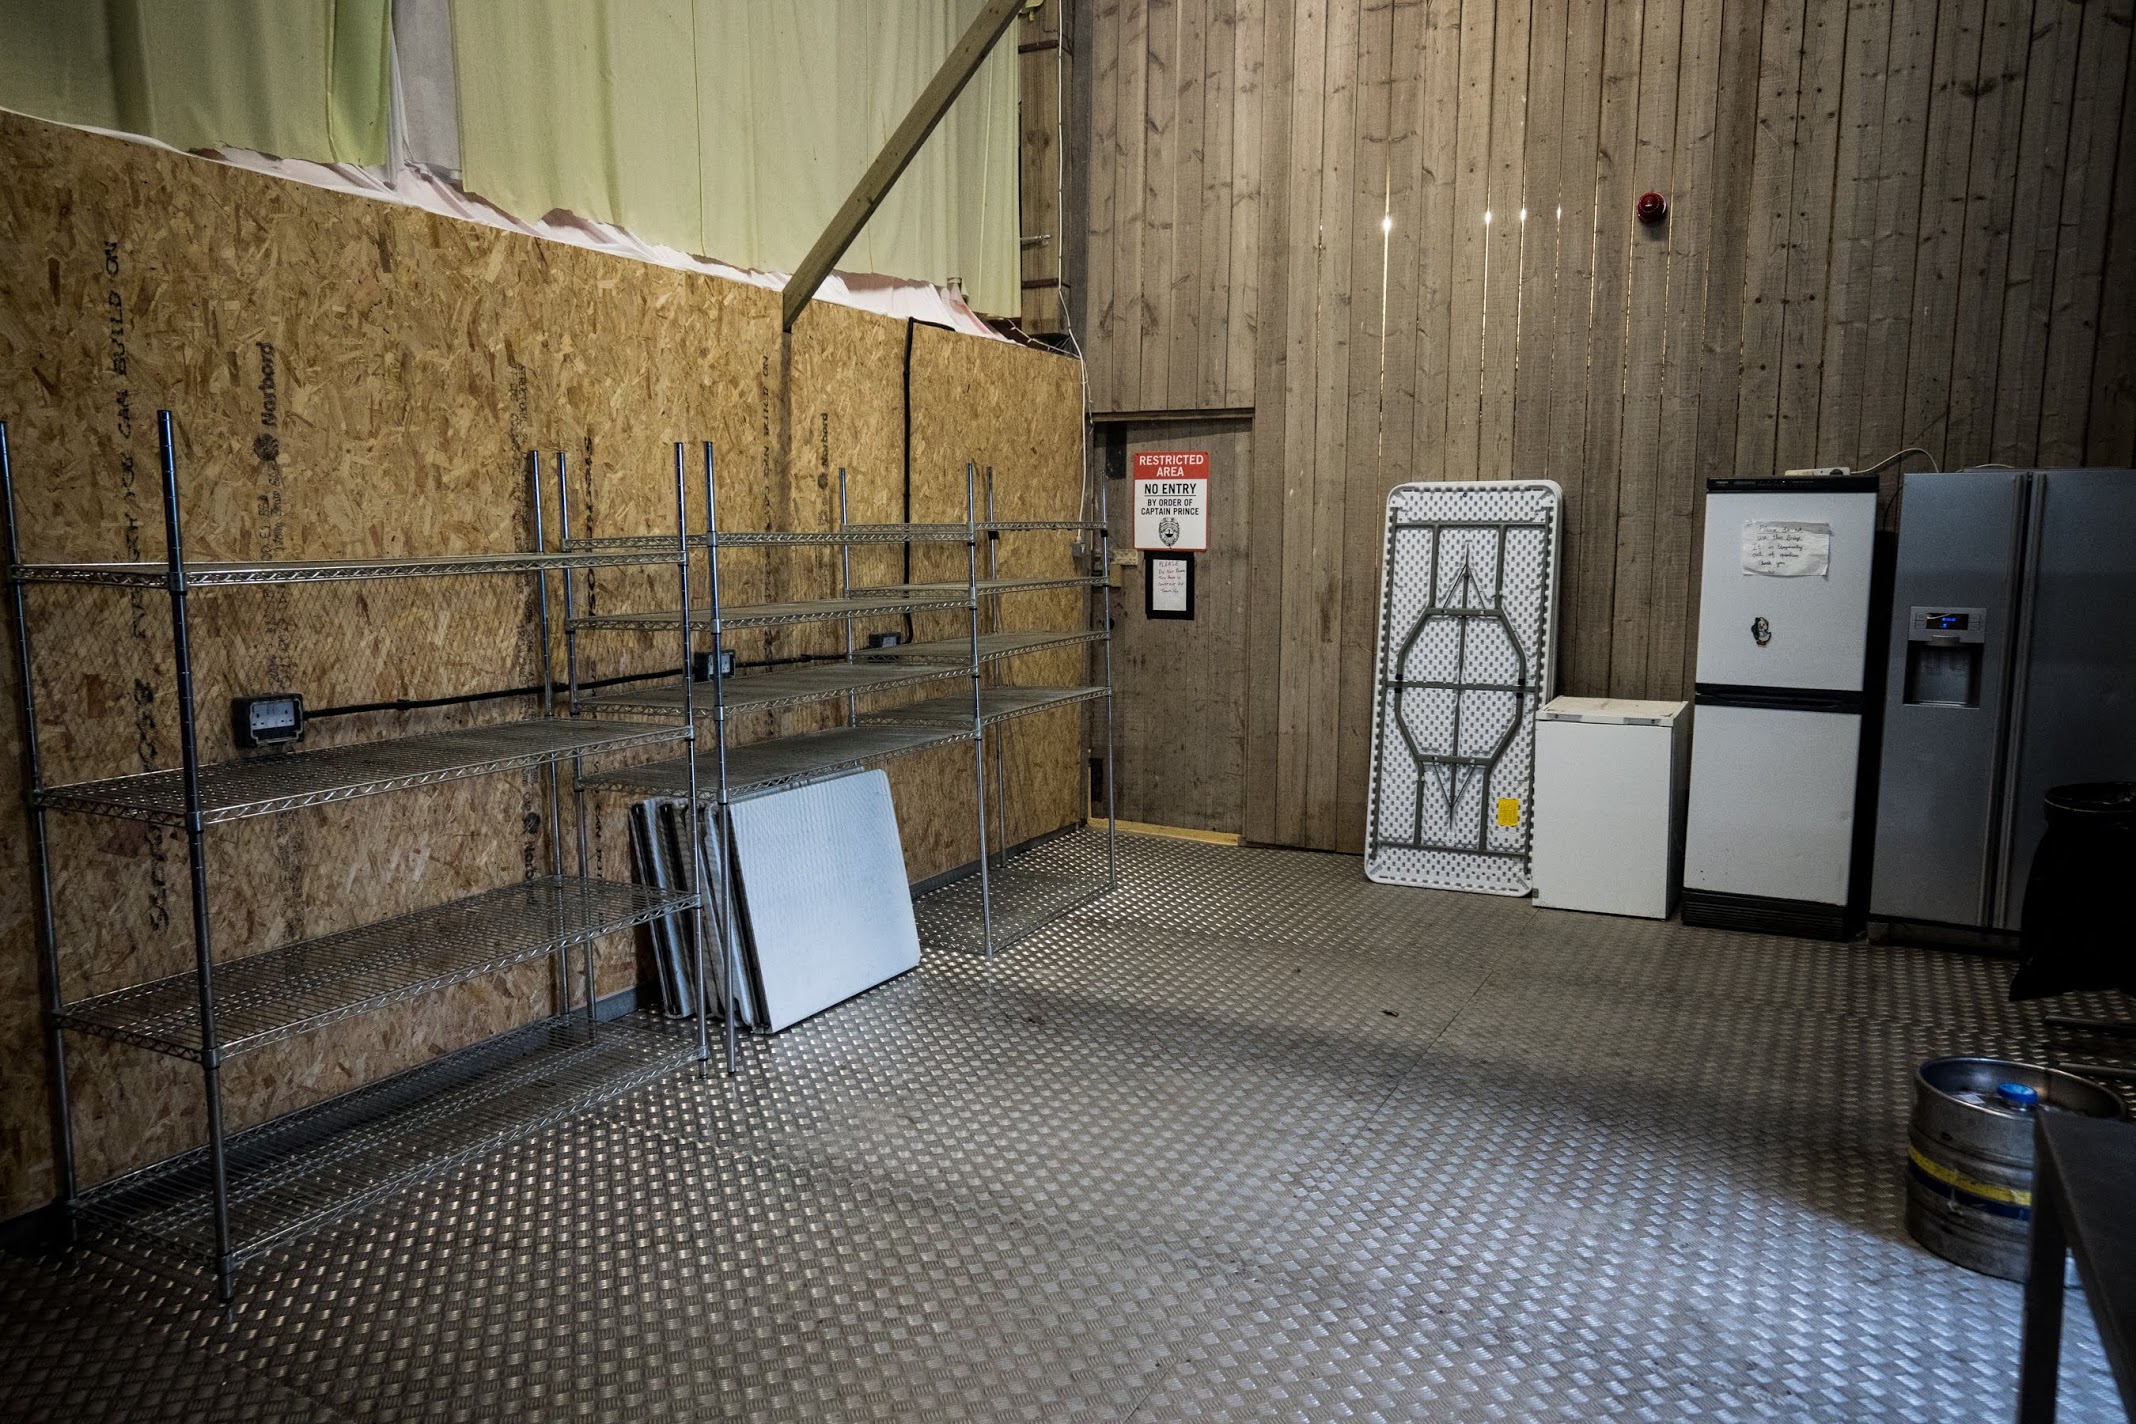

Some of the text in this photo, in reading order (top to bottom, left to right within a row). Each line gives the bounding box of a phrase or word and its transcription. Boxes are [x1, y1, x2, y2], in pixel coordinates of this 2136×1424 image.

[104, 241, 120, 278] ON
[107, 291, 127, 376] BUILD
[762, 355, 769, 377] ON
[255, 341, 278, 428] Norbord
[115, 390, 132, 440] CAN
[762, 386, 770, 437] BUILD
[820, 412, 829, 468] Norbord
[1139, 454, 1204, 466] RESTRICTED
[1156, 466, 1185, 477] AREA
[1144, 483, 1197, 495] NO ENTRY
[1147, 498, 1193, 507] BY ORDER OF
[1140, 507, 1199, 516] CAPTAIN PRINCE
[595, 803, 603, 839] CAN
